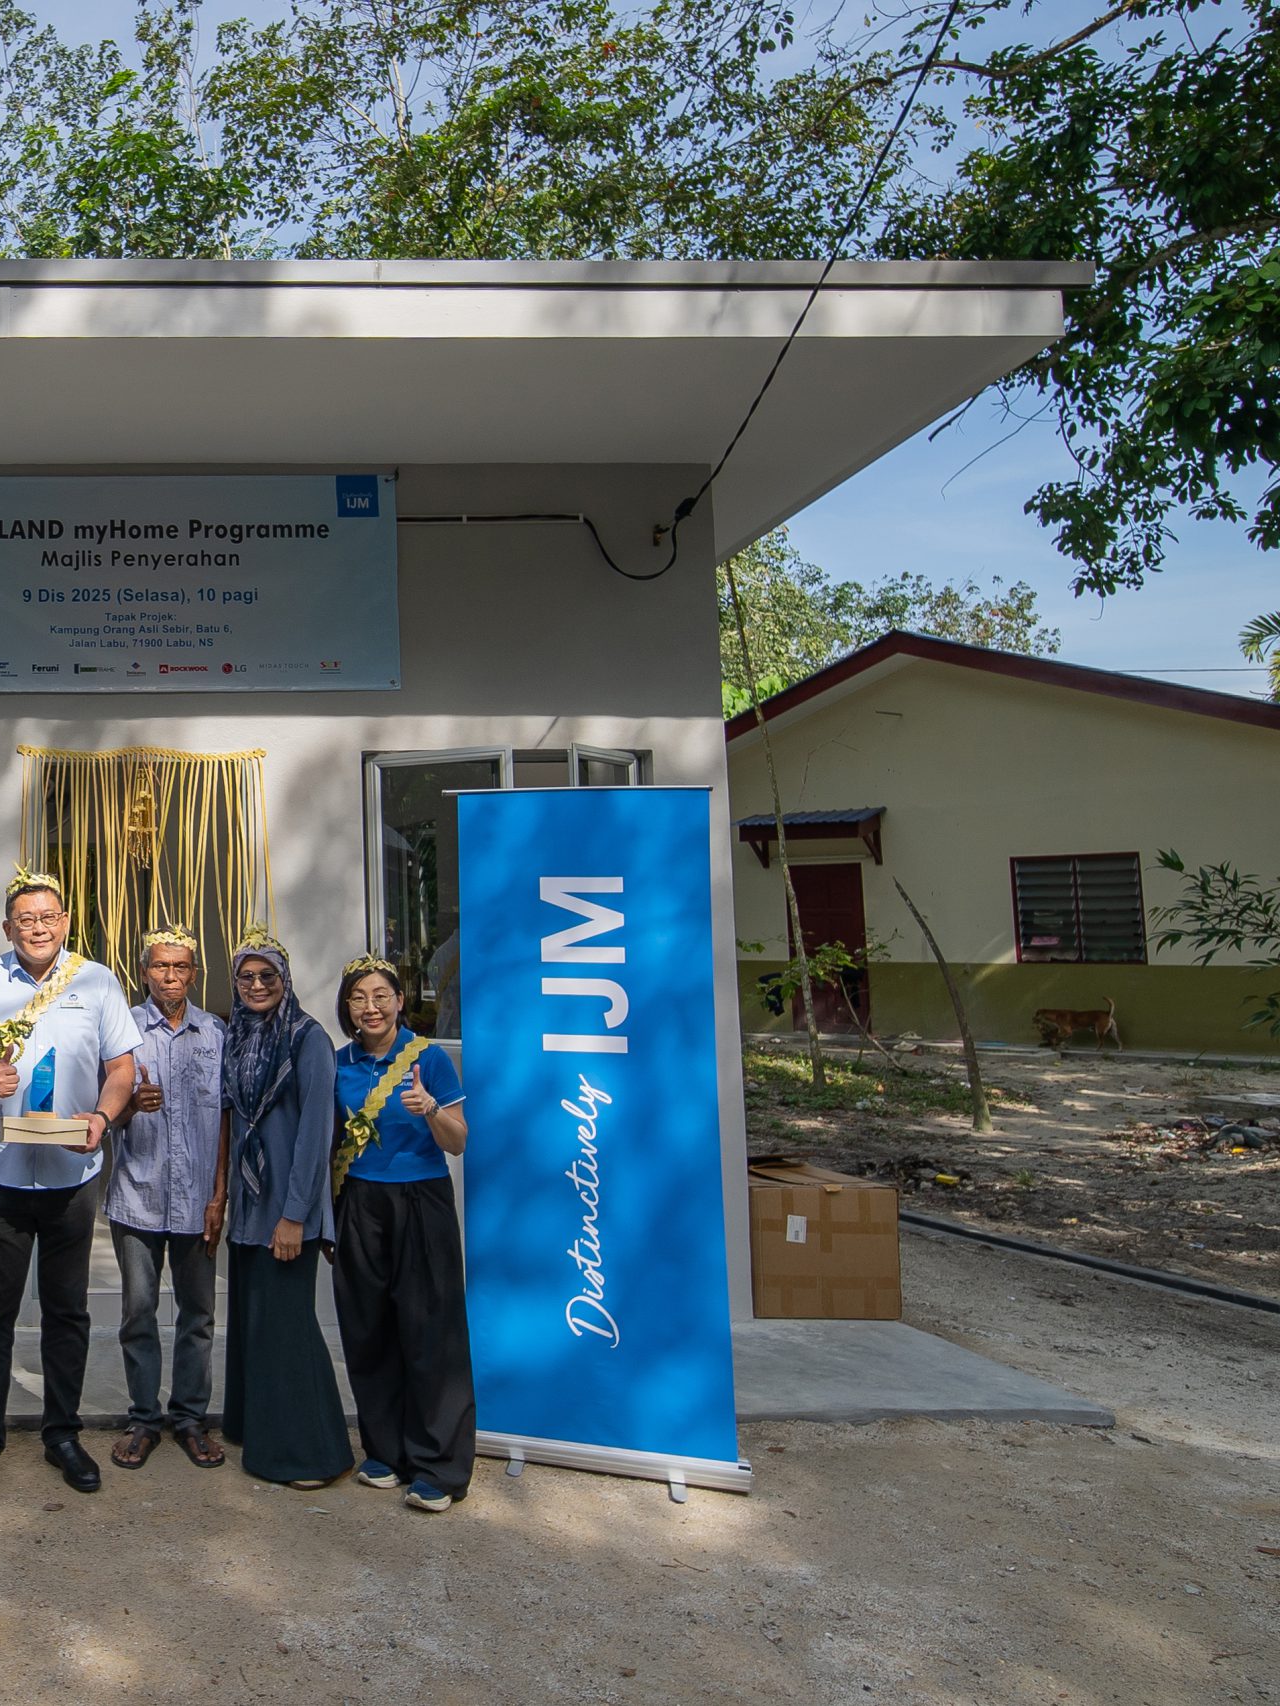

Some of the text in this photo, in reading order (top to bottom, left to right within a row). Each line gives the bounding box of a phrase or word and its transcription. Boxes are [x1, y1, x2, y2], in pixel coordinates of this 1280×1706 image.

[346, 497, 370, 509] IJM
[73, 519, 180, 545] myHome
[188, 519, 330, 545] Programme
[40, 550, 240, 572] Majlis Penyerahan
[22, 587, 259, 605] 9 Dis 2025 (Selasa), 10 pagi
[105, 612, 177, 623] Tapak Projek:
[49, 624, 233, 636] Kampung Orang Asli Sebir, Batu 6,
[68, 637, 214, 650] Jalan Labu, 71900 Labu, NS
[31, 663, 60, 672] Feruni
[169, 664, 209, 673] ROCKWOOL
[234, 664, 248, 673] LG
[539, 876, 629, 1348] Distinctively IJM
